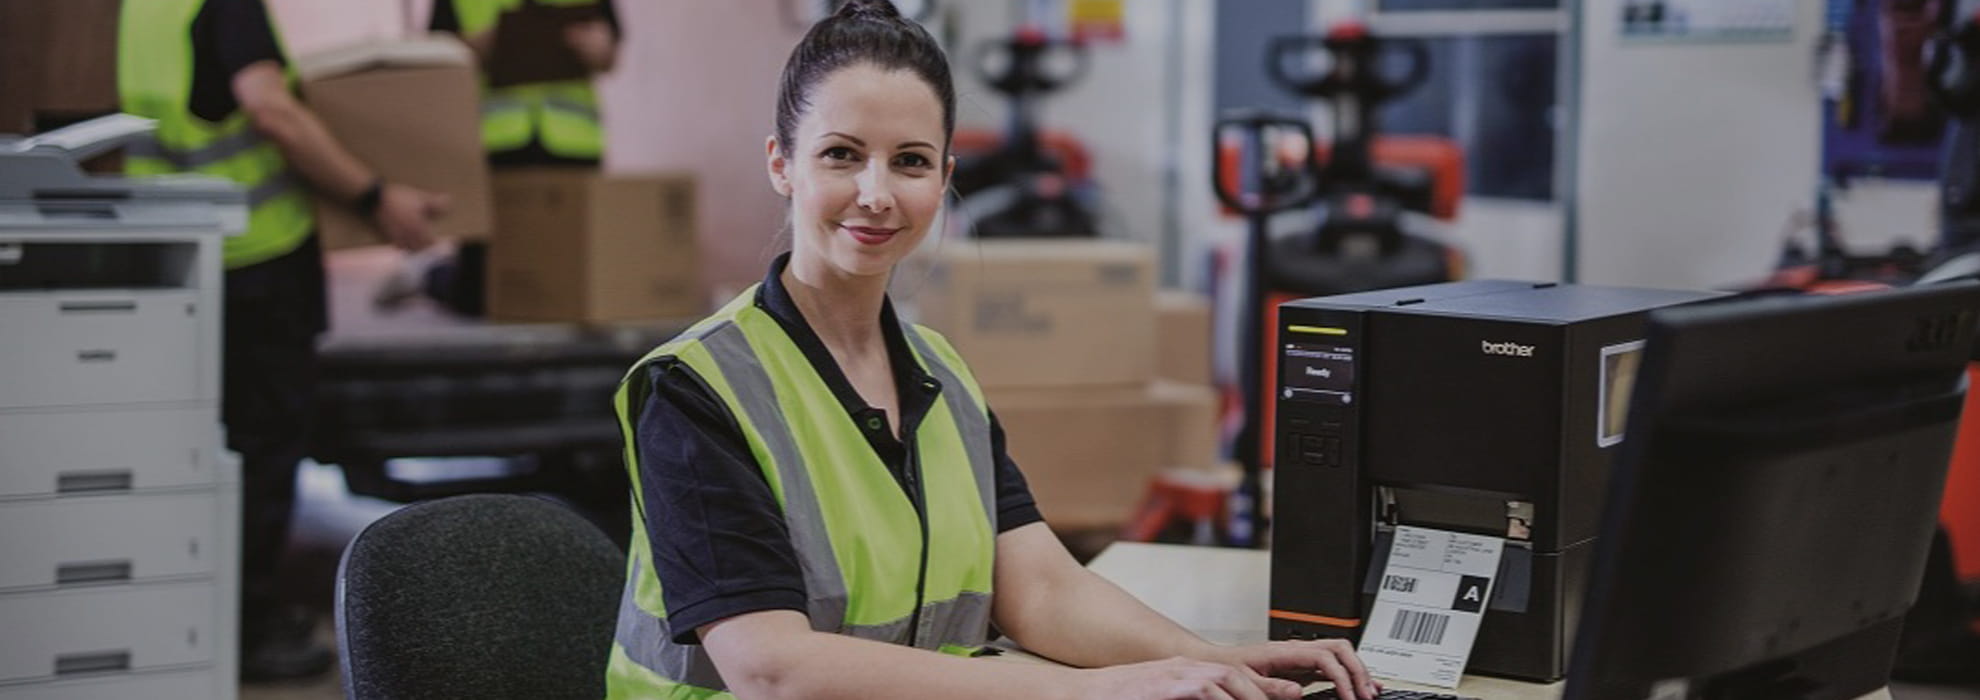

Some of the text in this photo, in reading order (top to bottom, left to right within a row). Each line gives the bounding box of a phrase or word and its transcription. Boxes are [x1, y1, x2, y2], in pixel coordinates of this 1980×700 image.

[1481, 340, 1536, 357] brother
[1305, 366, 1331, 378] Ready
[1463, 586, 1479, 602] A
